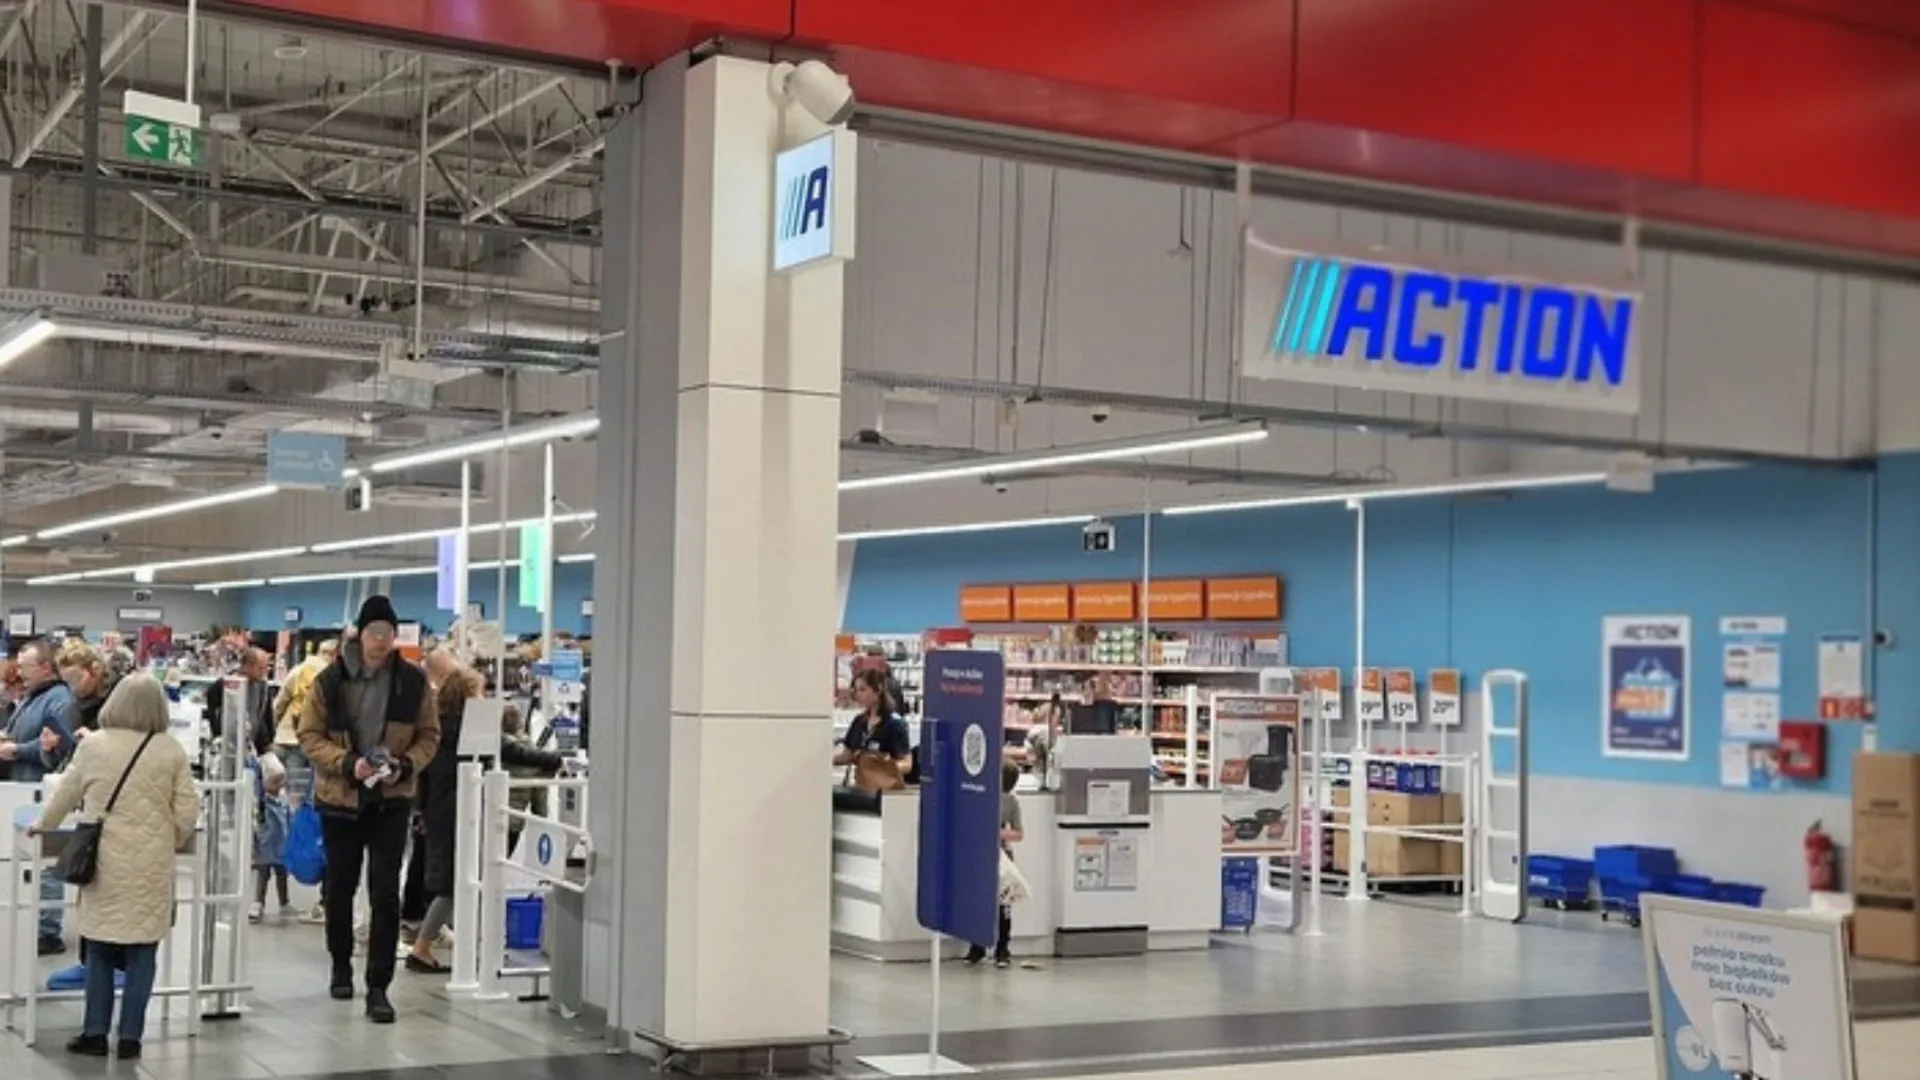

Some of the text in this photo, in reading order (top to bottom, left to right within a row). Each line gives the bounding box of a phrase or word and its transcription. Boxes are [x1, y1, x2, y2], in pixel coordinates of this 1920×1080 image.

[800, 165, 827, 235] A
[1326, 264, 1632, 385] ACTION
[1623, 624, 1681, 640] ACTION
[1709, 976, 1732, 991] bez
